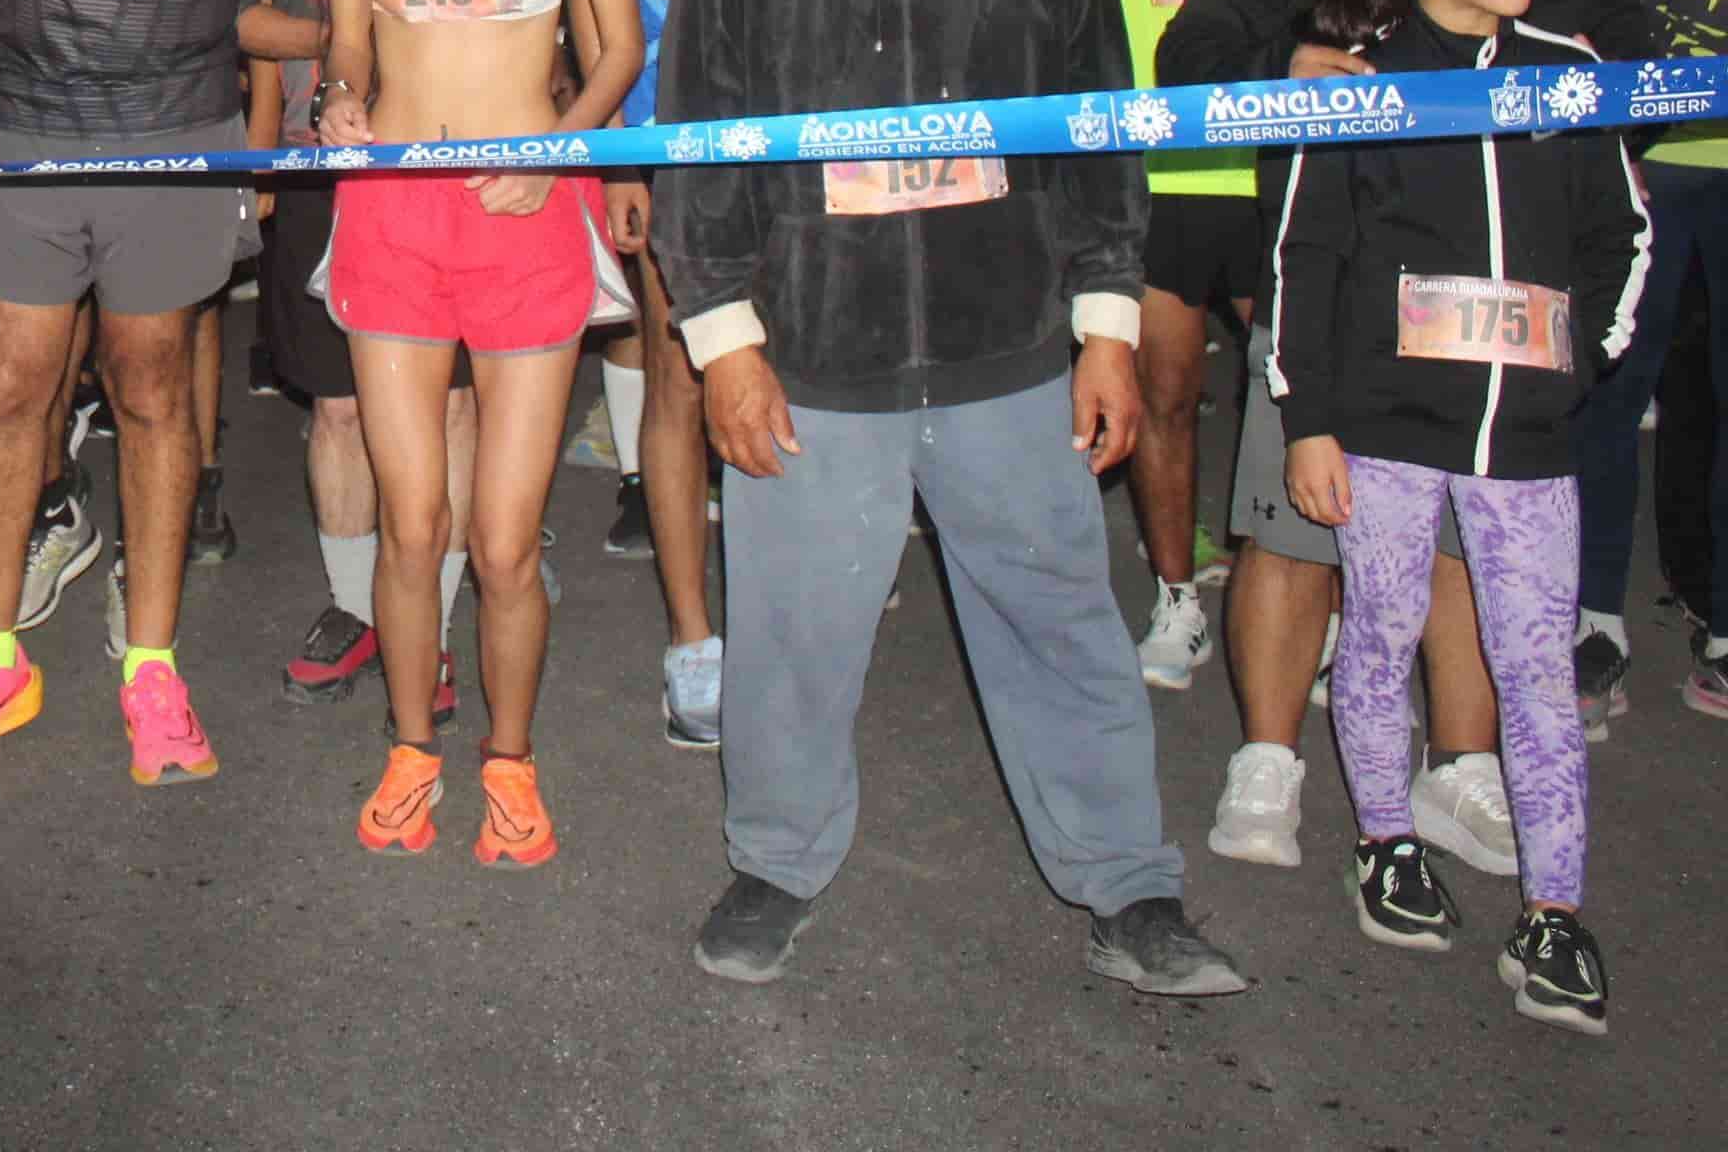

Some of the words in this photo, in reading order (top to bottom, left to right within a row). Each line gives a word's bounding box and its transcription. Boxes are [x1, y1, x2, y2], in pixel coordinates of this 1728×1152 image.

[1204, 84, 1405, 121] MONCLOVA
[799, 110, 994, 145] MONCLOVA
[1204, 124, 1301, 143] GOBIERNO
[1307, 122, 1332, 138] EN
[400, 137, 590, 161] MONCLOVA
[798, 145, 892, 159] GOBIERNO
[898, 142, 922, 154] EN
[928, 136, 997, 153] ACCIÓN
[26, 155, 209, 173] MONCLOVA
[1414, 280, 1457, 297] CARRERA
[1455, 298, 1529, 347] 175
